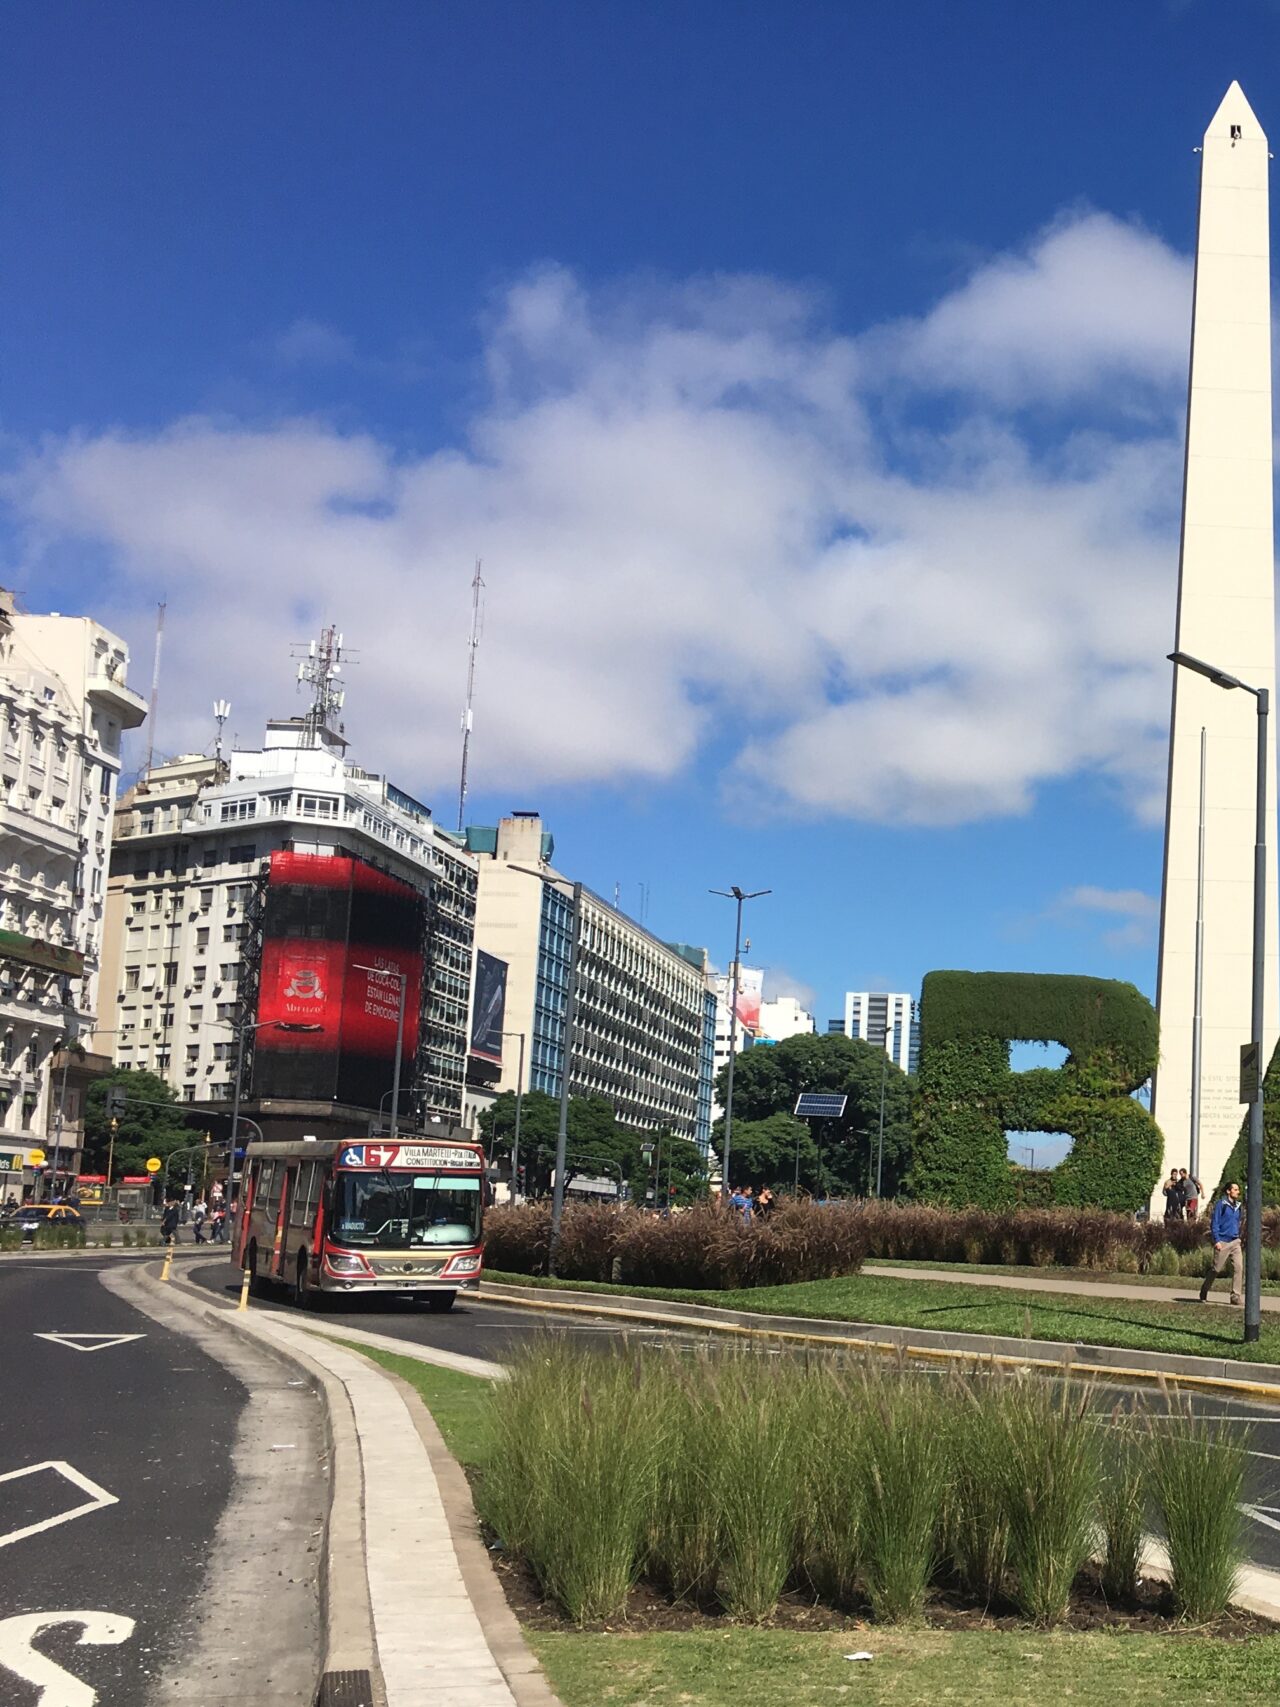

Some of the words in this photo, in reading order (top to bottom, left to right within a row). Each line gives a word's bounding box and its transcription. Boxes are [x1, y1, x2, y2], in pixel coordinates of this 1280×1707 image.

[367, 970, 374, 982] DE
[375, 972, 402, 991] COCA-COL
[365, 1001, 372, 1014] DE
[372, 1003, 400, 1022] EMOCIONE
[365, 1145, 400, 1167] 67
